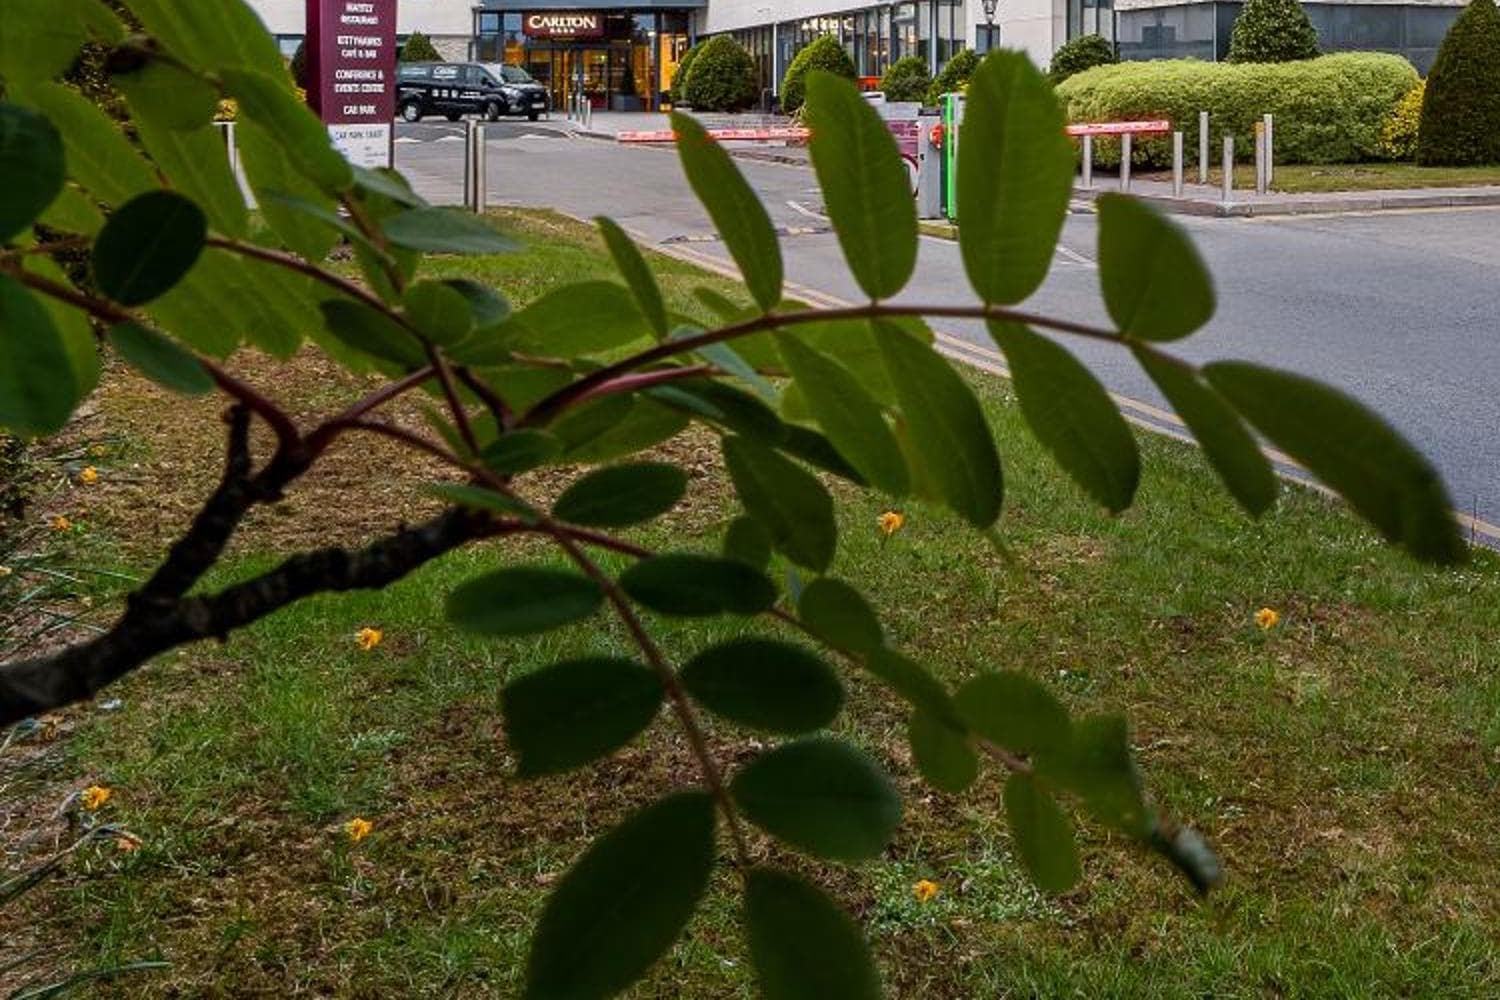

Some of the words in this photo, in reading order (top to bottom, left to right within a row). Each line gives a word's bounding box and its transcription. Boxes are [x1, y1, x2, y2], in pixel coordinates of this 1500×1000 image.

[528, 15, 597, 29] CARLTON
[335, 69, 376, 80] CONFERENCE
[343, 105, 358, 115] CAR
[359, 105, 377, 115] PARK
